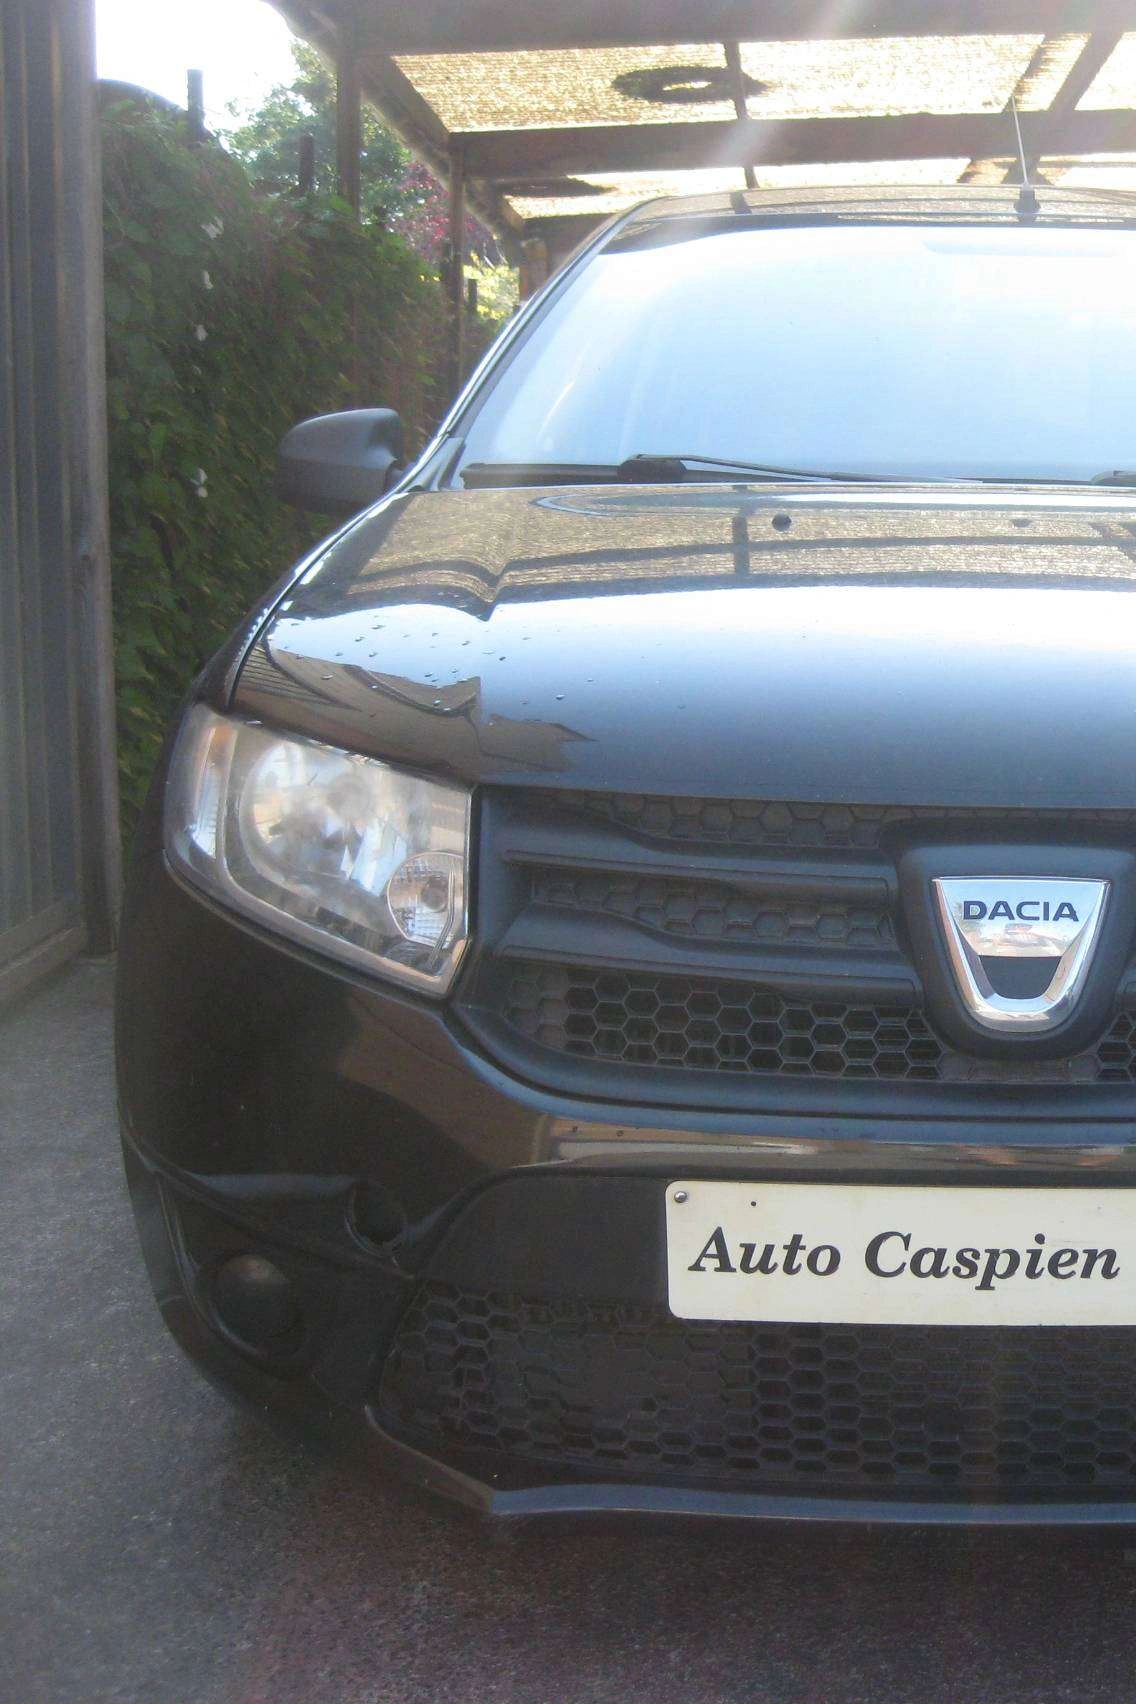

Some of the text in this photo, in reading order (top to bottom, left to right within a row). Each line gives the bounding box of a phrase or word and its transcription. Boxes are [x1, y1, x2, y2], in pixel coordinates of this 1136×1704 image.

[963, 900, 1079, 922] DACIA
[687, 1226, 1121, 1291] Auto Caspien
